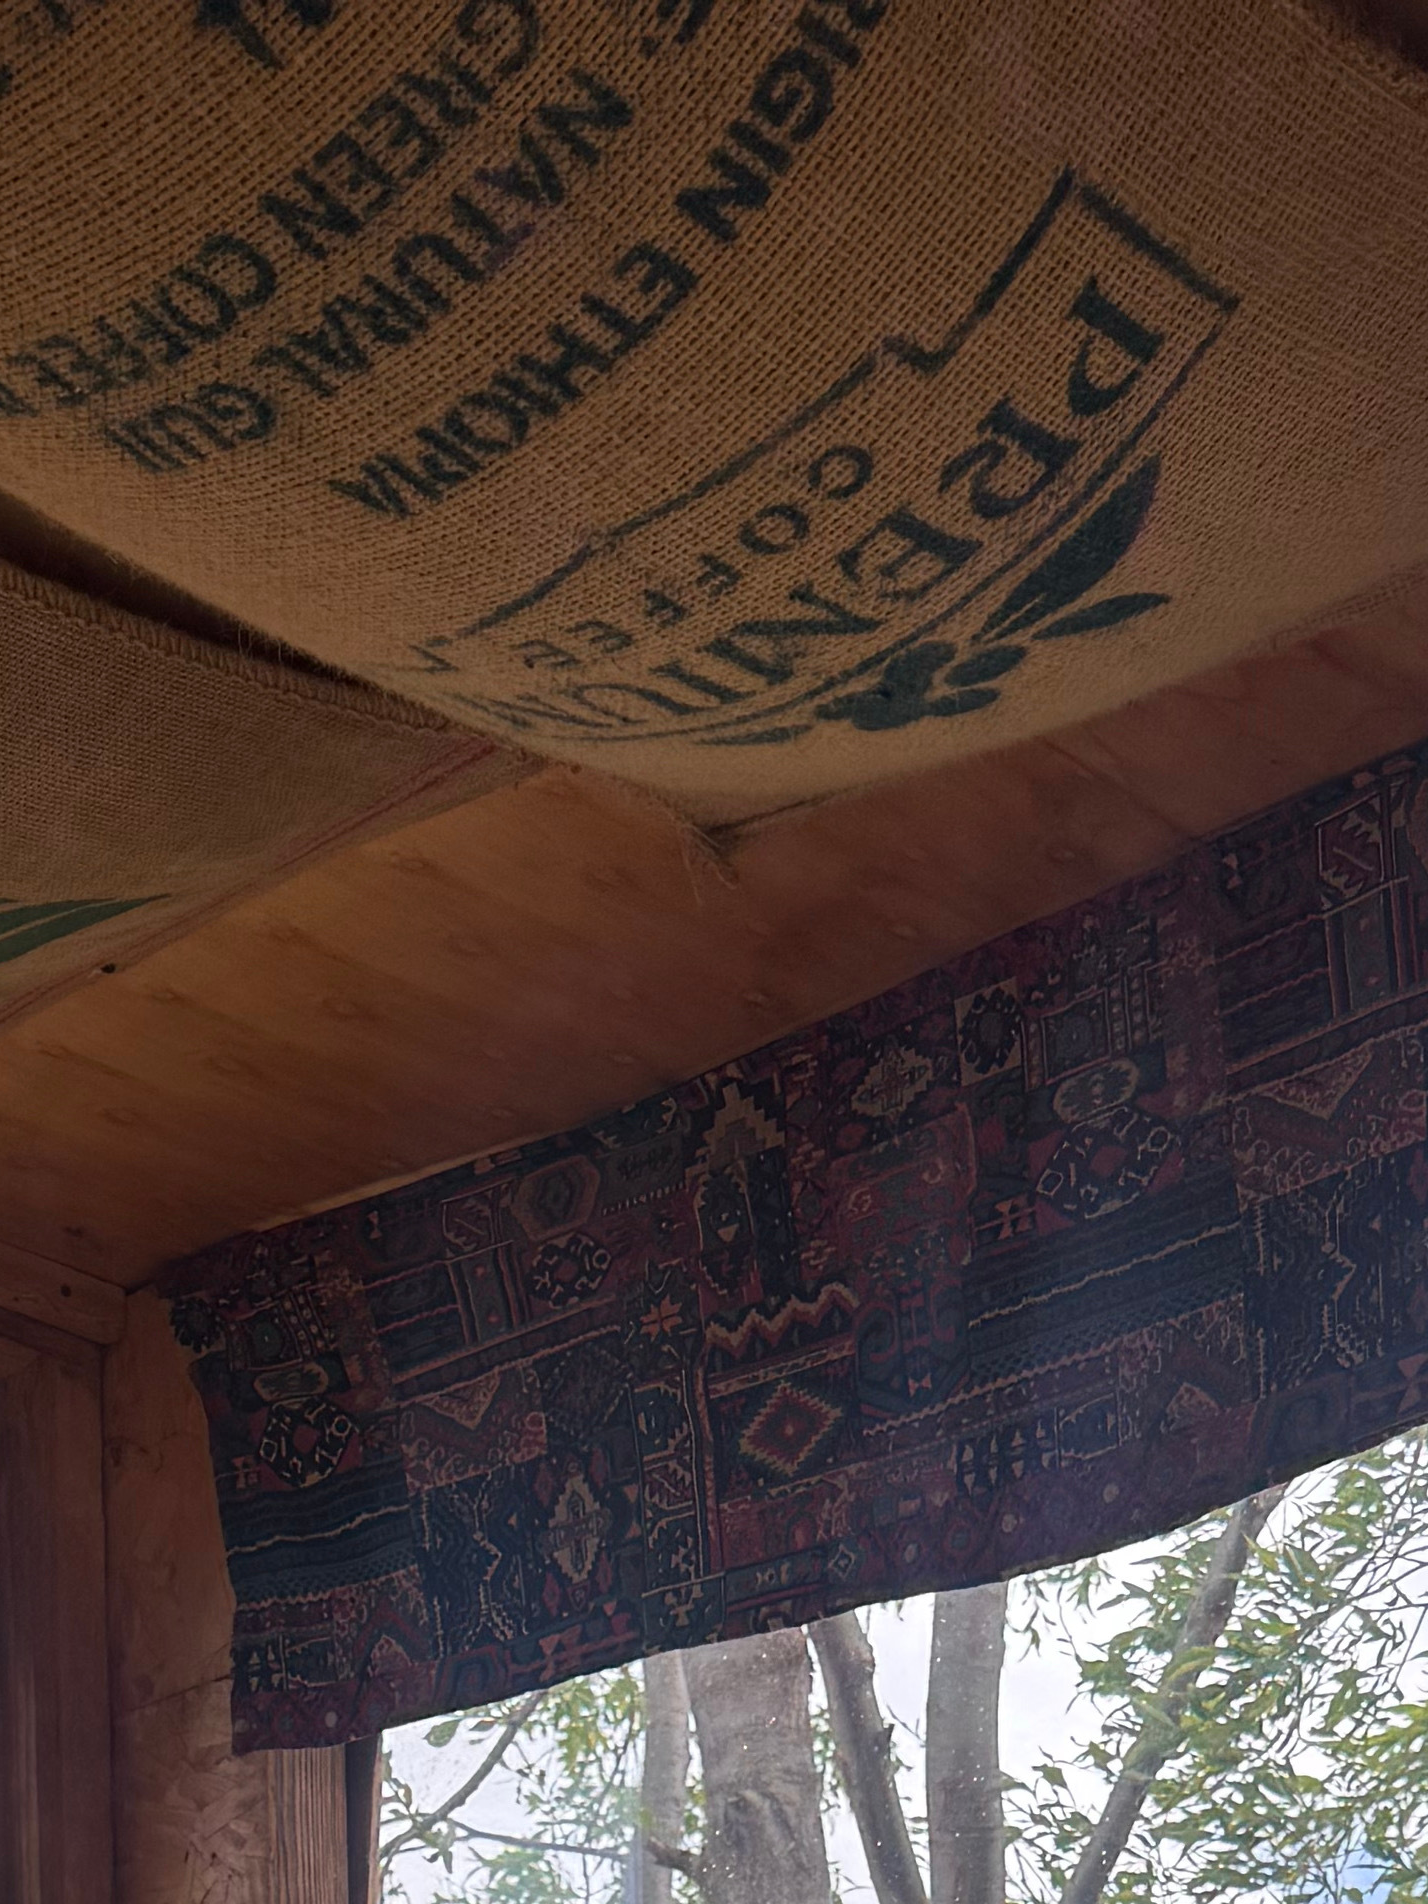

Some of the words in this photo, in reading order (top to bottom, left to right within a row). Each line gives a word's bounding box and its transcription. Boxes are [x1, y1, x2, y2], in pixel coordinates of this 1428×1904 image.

[253, 68, 634, 398] NATURAL
[258, 0, 539, 260] GREEN
[8, 235, 276, 406] COFFEE
[328, 241, 697, 518] ETHIOPIA
[520, 445, 873, 670] COFFEE
